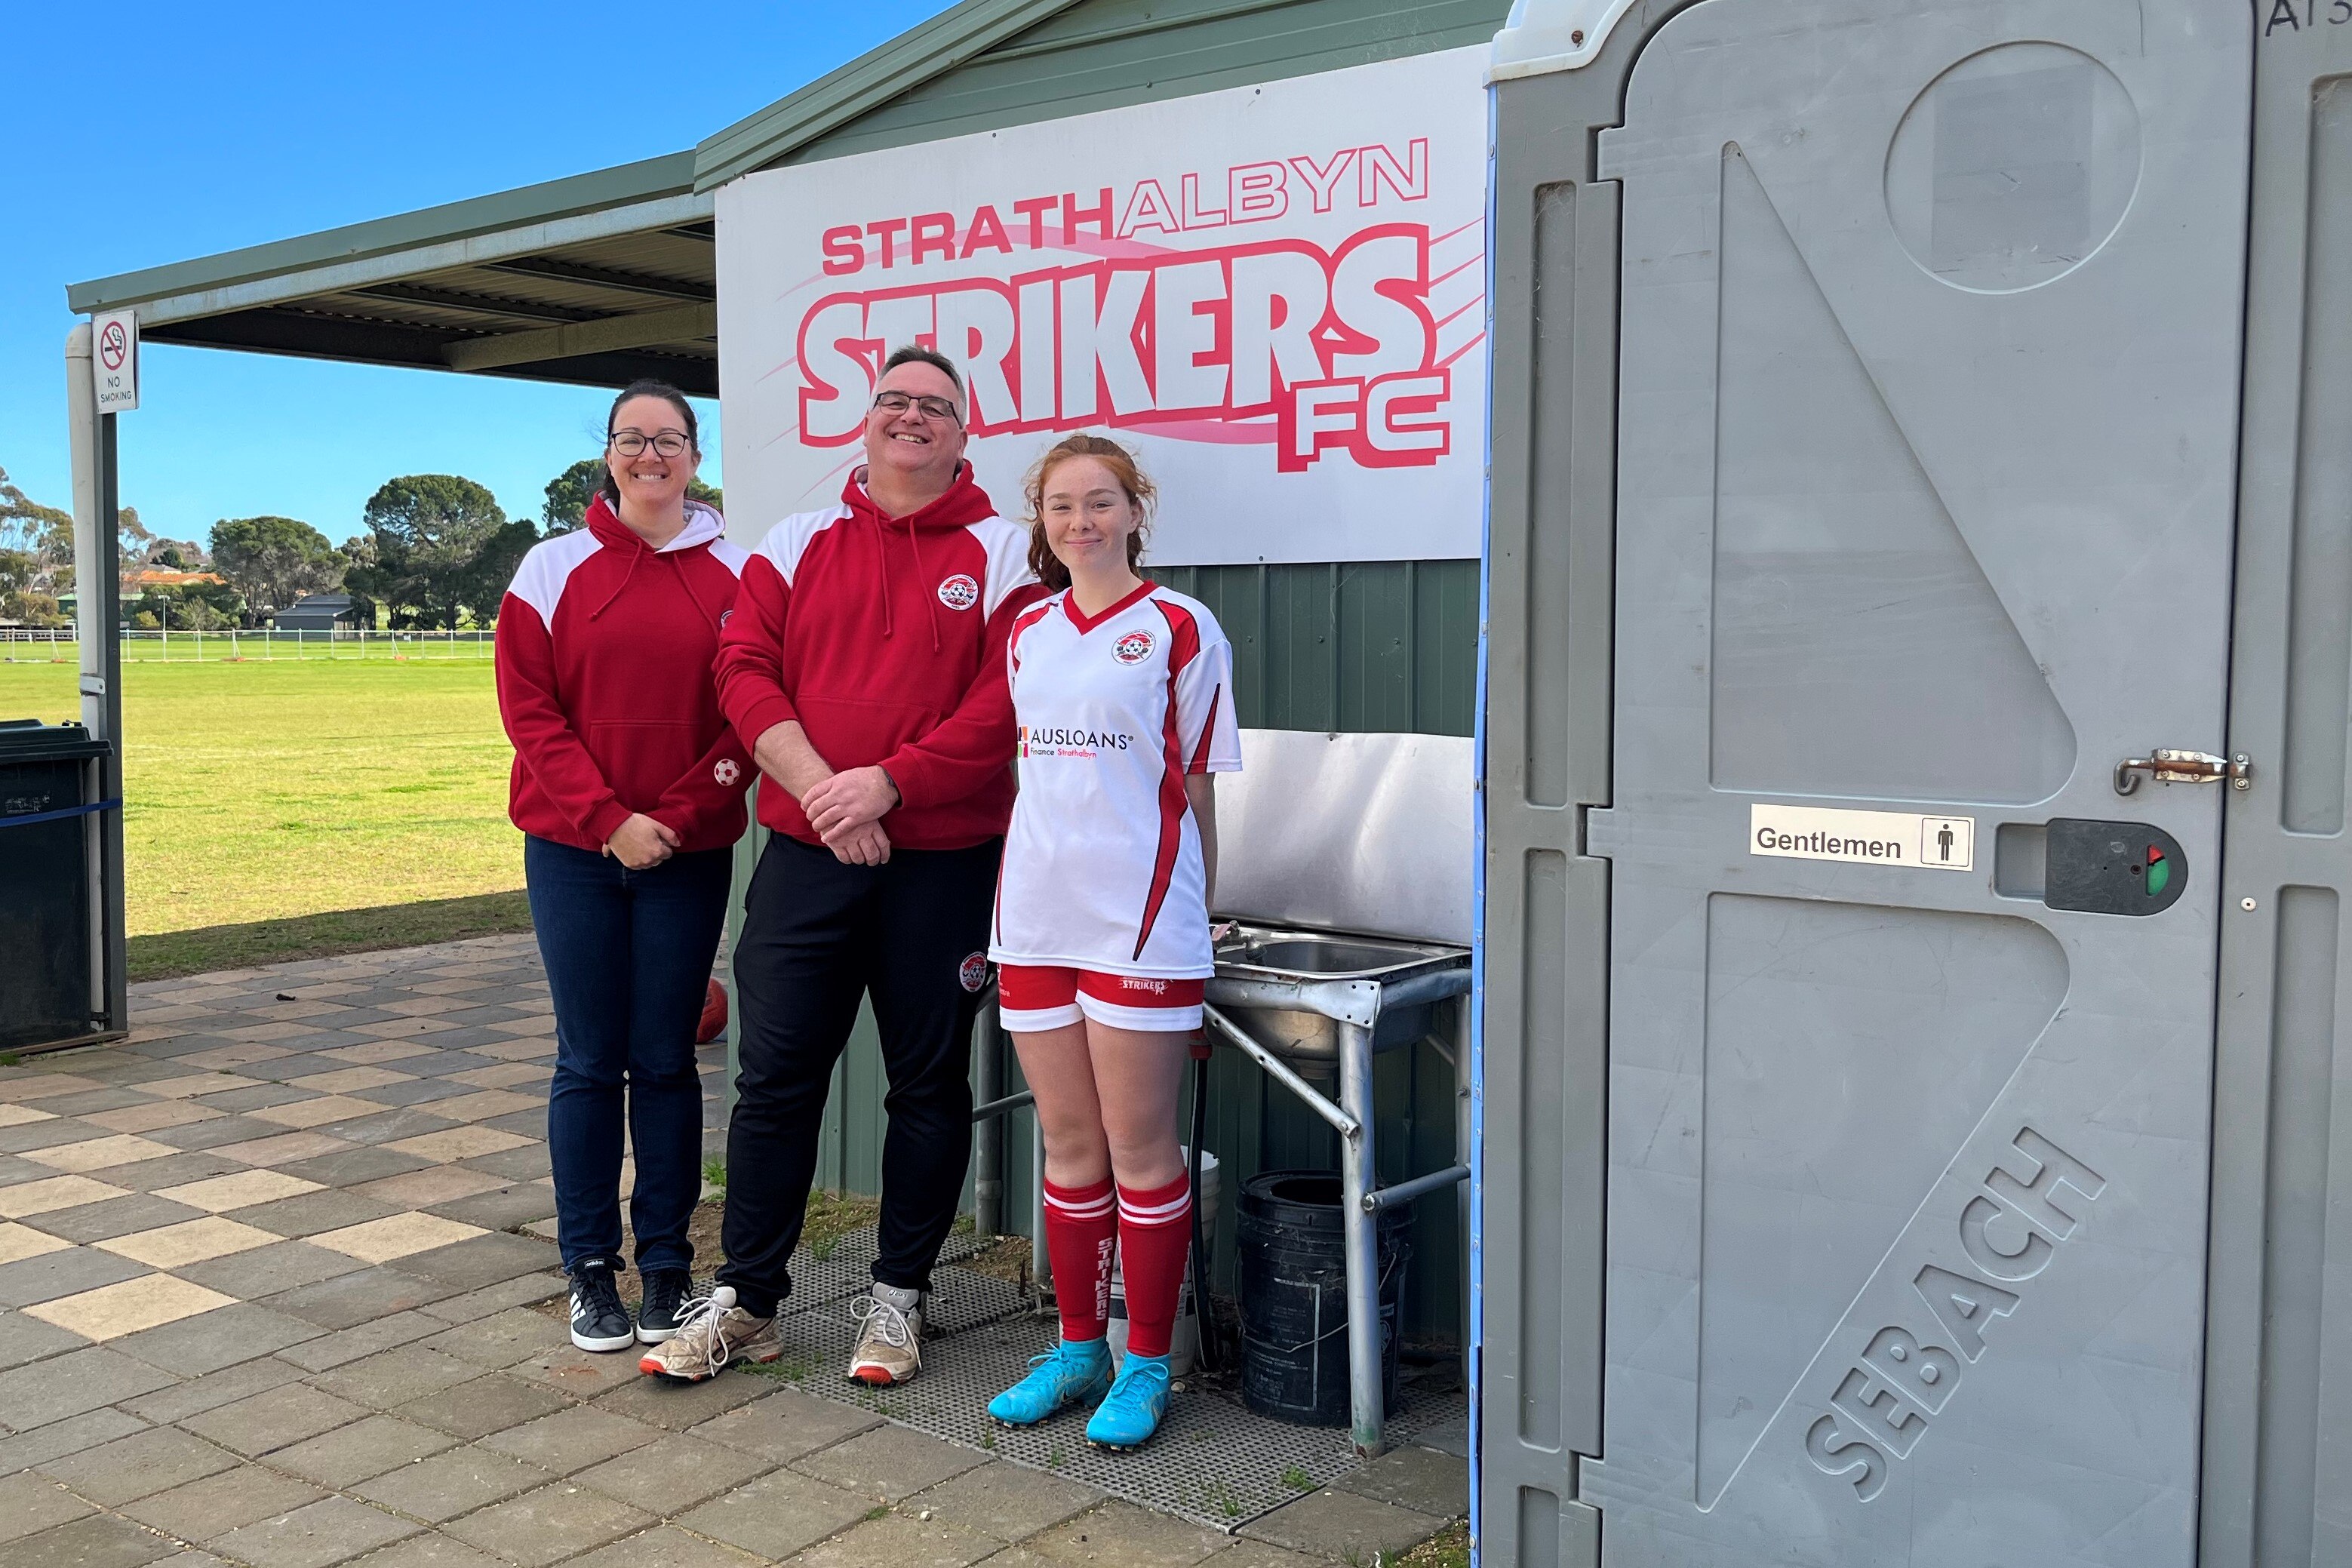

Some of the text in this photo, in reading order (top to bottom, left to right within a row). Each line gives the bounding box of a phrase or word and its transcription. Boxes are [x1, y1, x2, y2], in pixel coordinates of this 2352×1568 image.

[822, 137, 1428, 276] STRATHALBYN
[100, 390, 132, 403] SMOKING
[107, 376, 121, 388] NO
[1277, 367, 1450, 472] FC
[1057, 748, 1097, 760] Strathalbyn
[1757, 826, 1902, 859] Gentlemen
[1122, 979, 1165, 991] STRIKERS
[1095, 1237, 1115, 1321] STRIKERS
[1806, 1126, 2107, 1503] SEBACH
